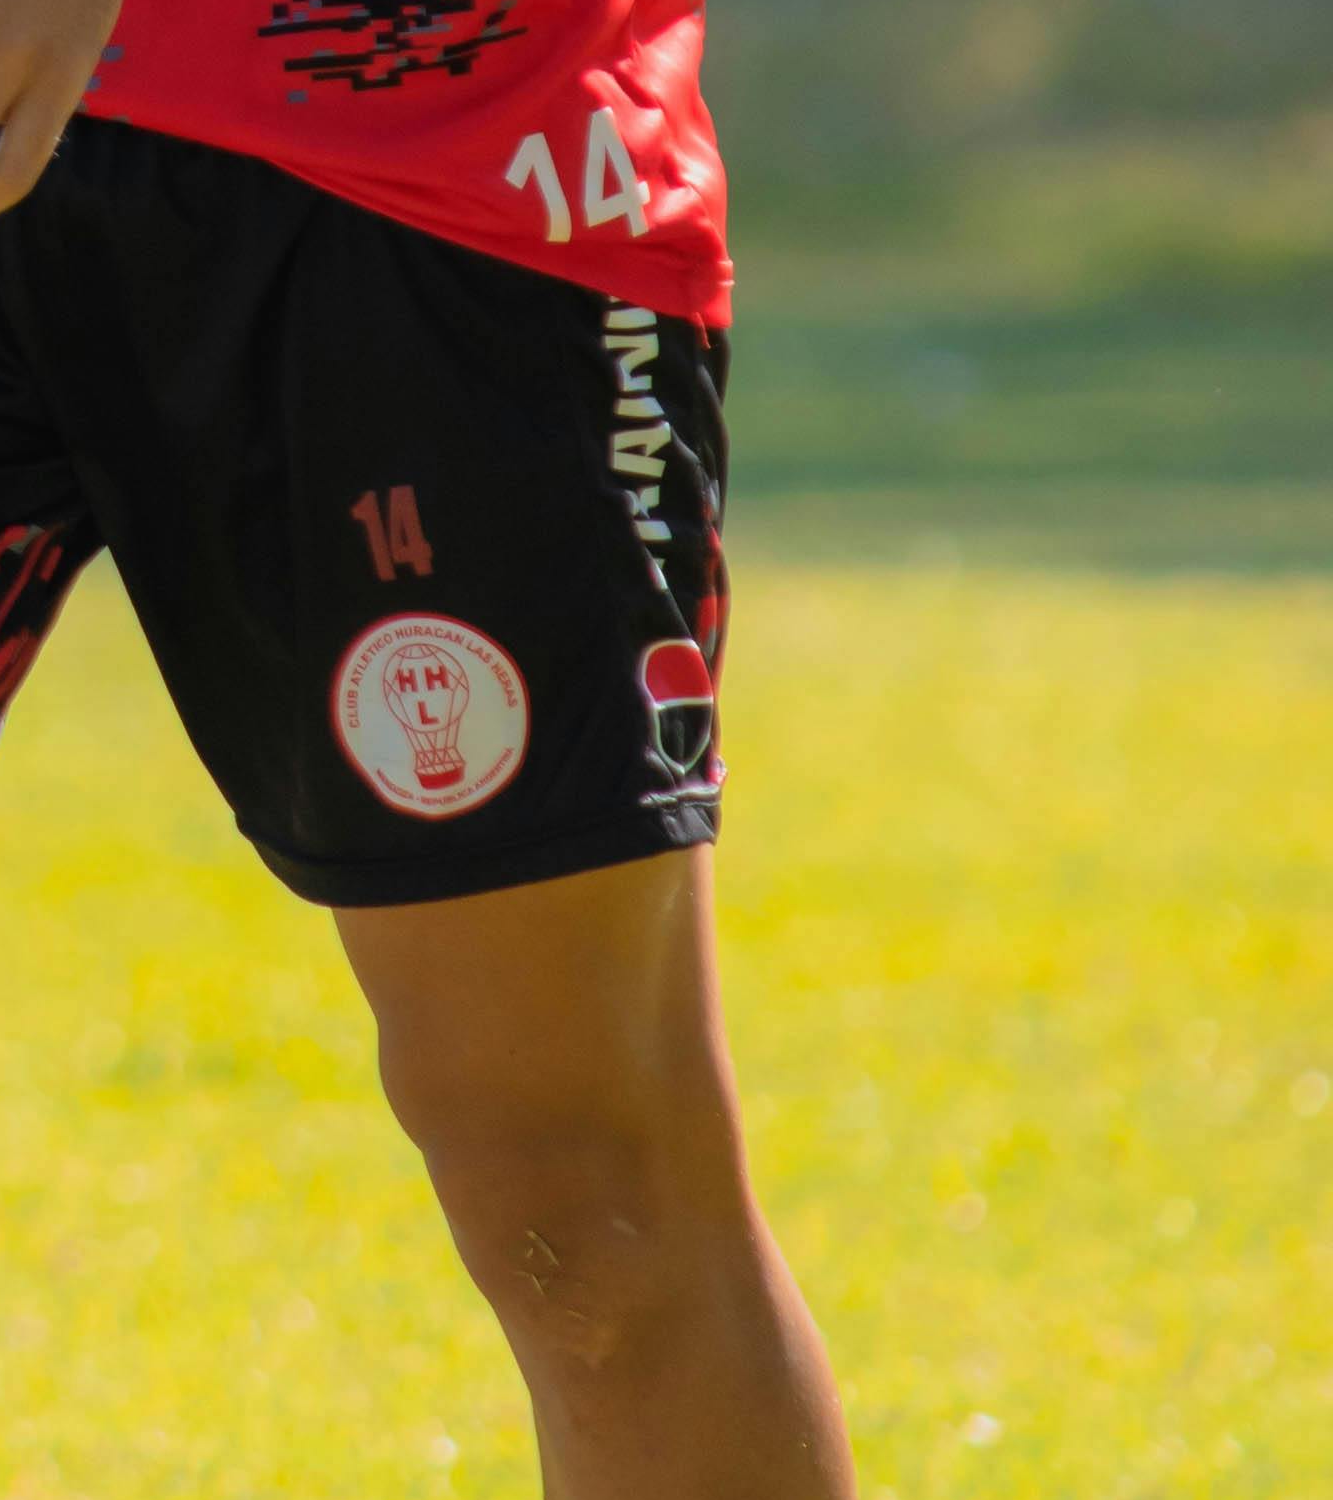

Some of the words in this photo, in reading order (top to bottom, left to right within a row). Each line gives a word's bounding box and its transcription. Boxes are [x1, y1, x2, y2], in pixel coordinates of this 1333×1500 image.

[505, 105, 651, 243] 14
[350, 484, 434, 583] 14
[350, 632, 394, 687] ATLETICO
[394, 624, 465, 647] HURACAN
[465, 640, 492, 665] LAS
[491, 660, 518, 709] HERAS
[346, 690, 362, 729] CLUB
